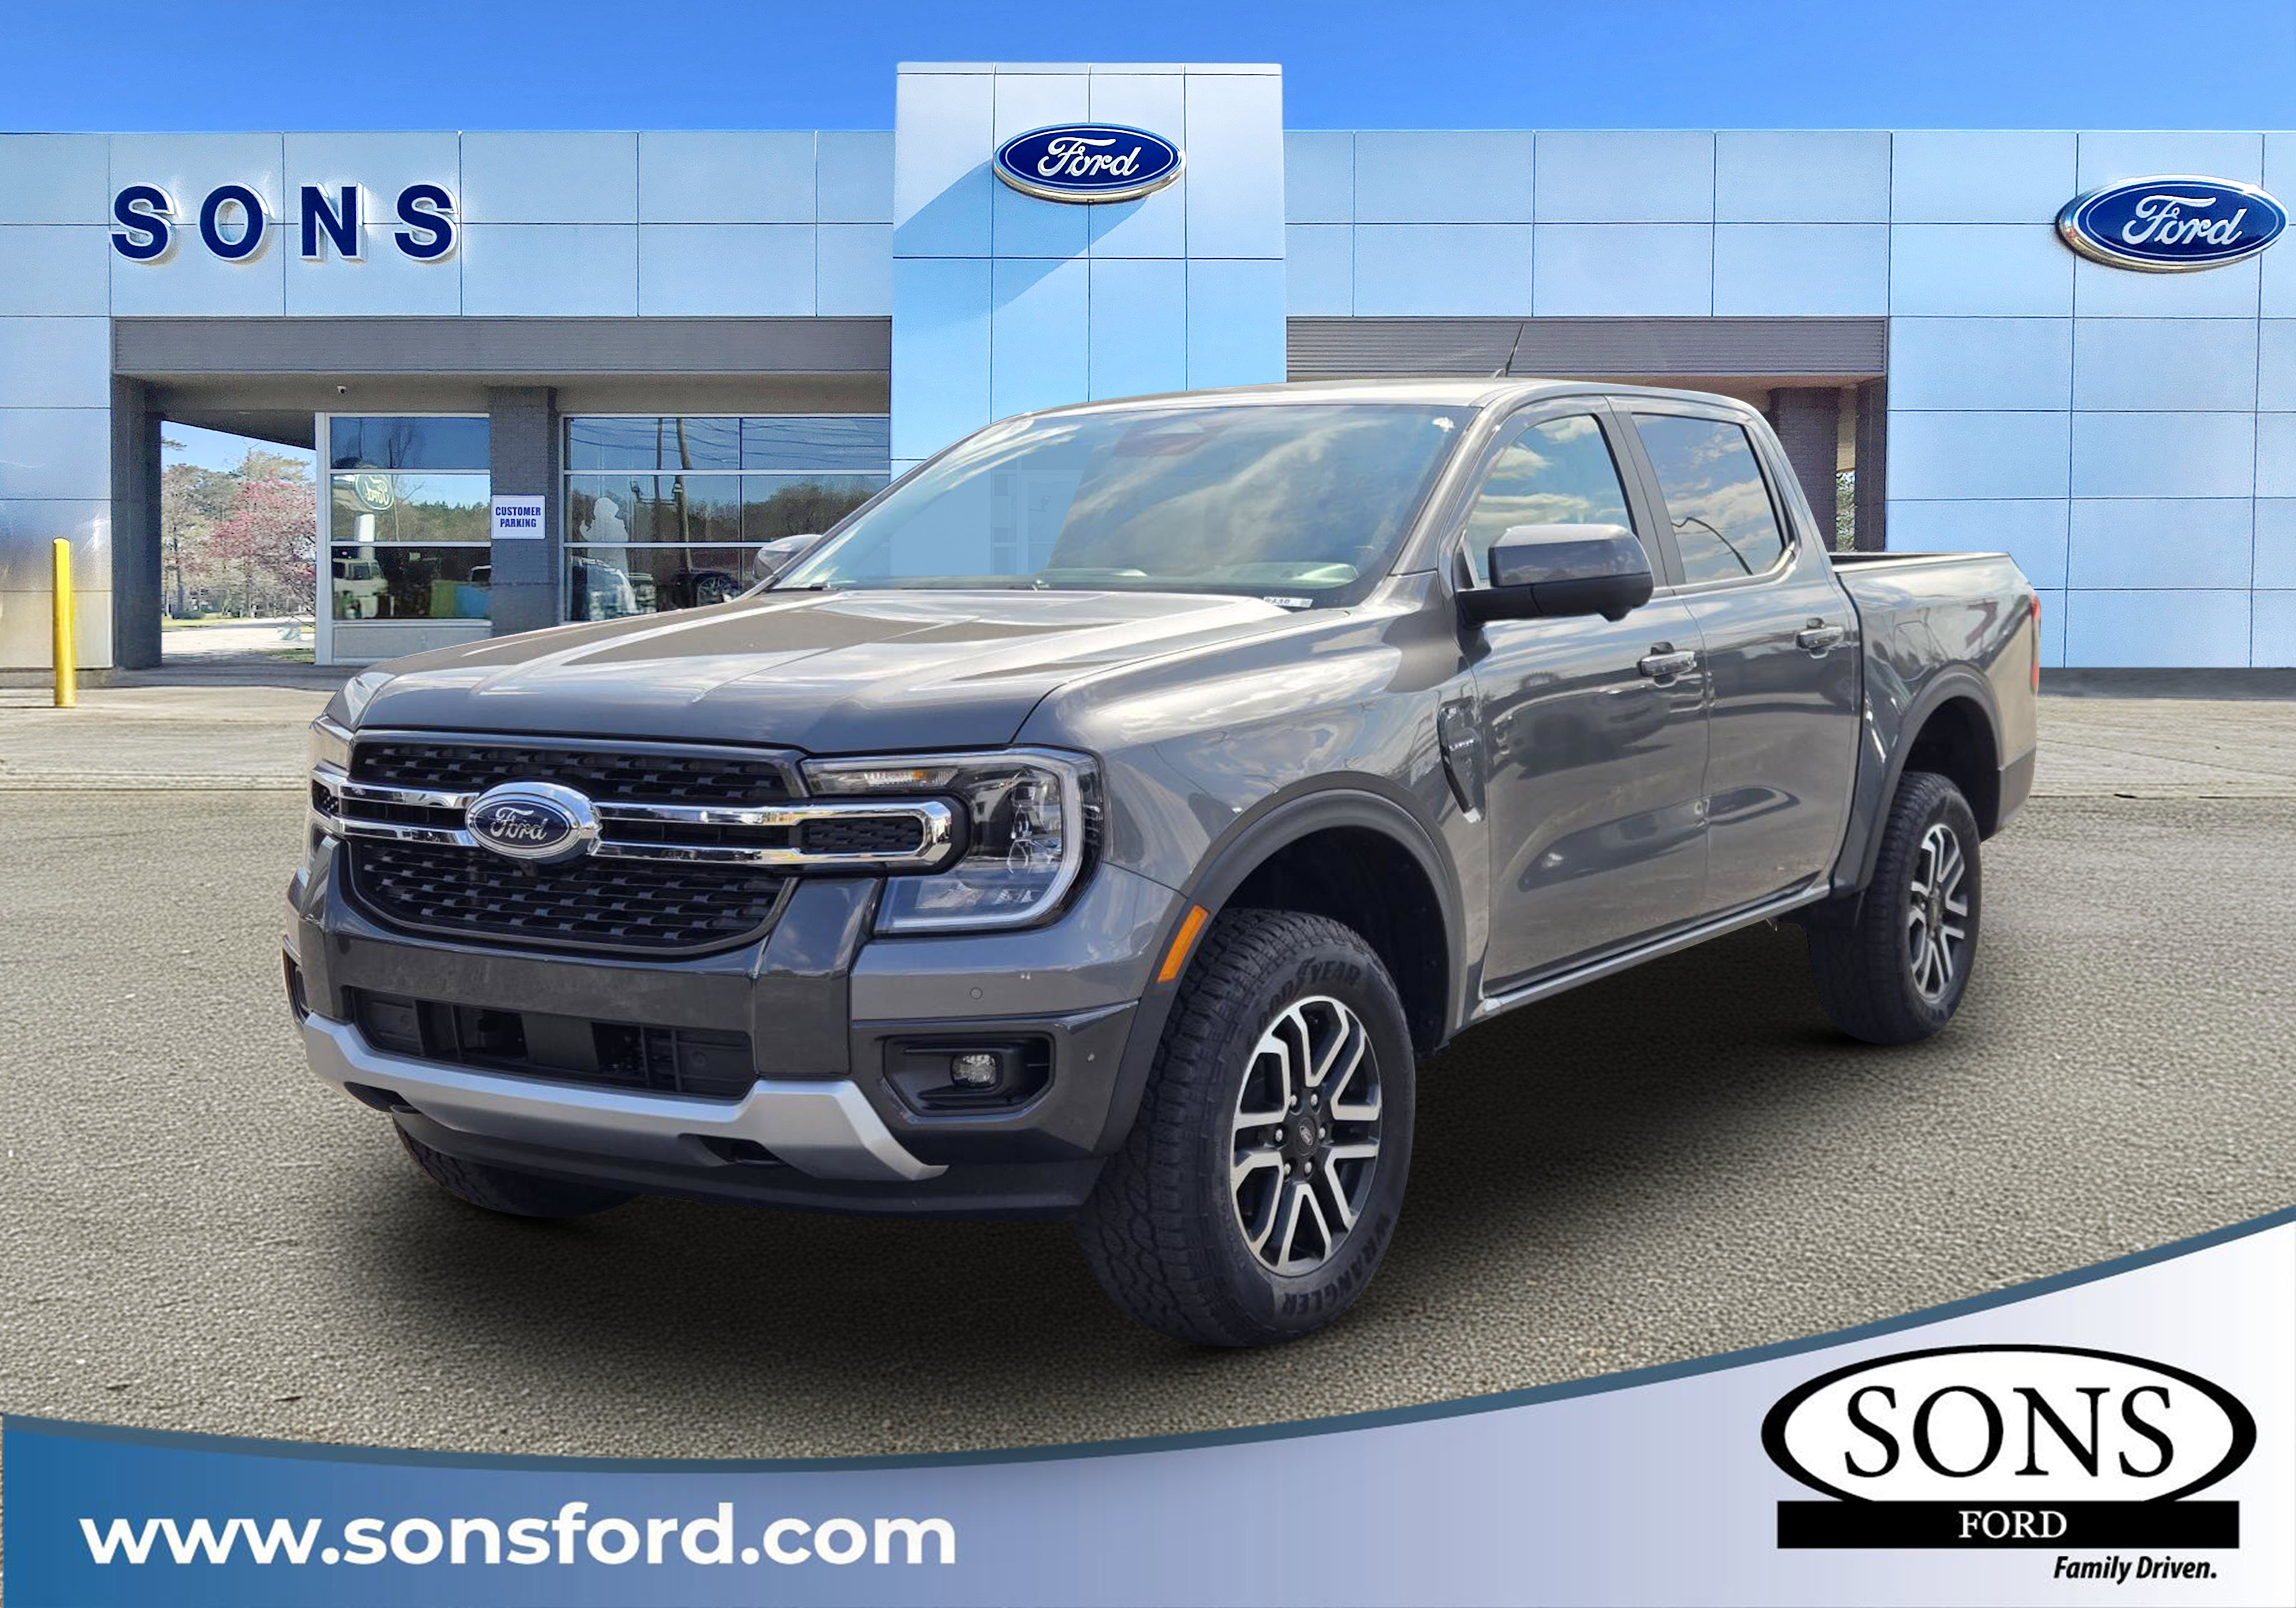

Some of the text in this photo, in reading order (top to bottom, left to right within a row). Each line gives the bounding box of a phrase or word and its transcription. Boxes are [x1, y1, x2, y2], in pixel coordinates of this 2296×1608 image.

[1038, 137, 1141, 176] Ford
[111, 182, 457, 260] SONS
[2122, 195, 2248, 245] Ford
[495, 506, 541, 516] CUSTOMER
[500, 518, 537, 527] PARKING
[490, 806, 548, 840] Ford
